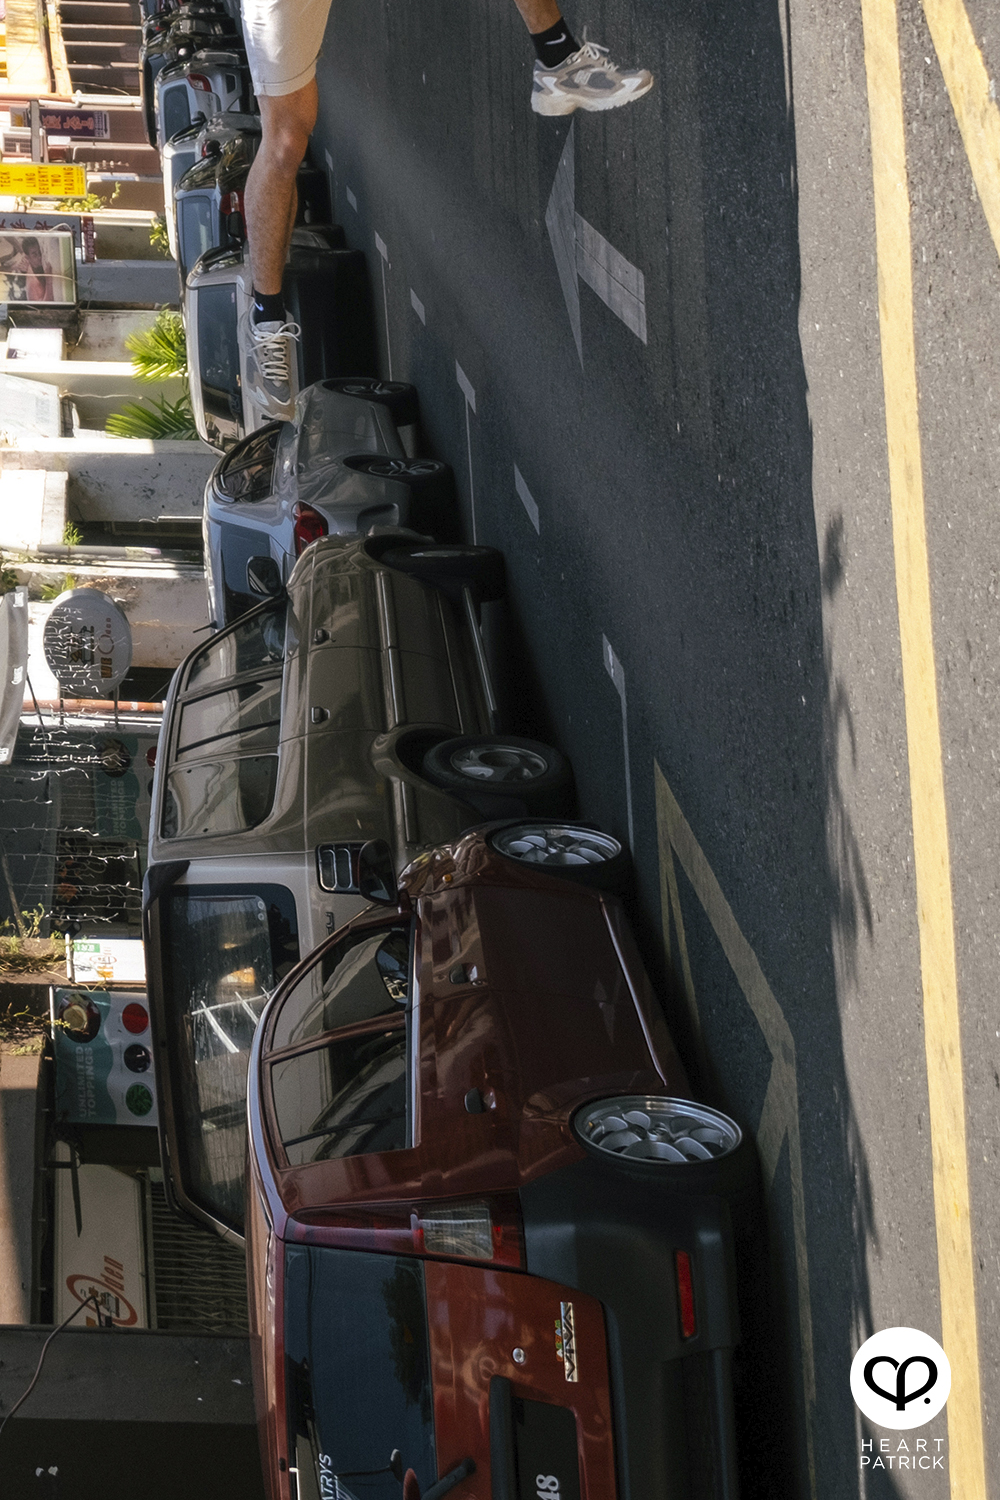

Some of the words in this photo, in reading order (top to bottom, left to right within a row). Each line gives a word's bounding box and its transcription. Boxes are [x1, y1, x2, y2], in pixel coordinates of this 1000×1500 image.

[0, 171, 11, 188] TECK
[26, 172, 37, 188] LING
[38, 166, 49, 195] SEVENTY
[51, 173, 61, 187] TWO
[63, 166, 75, 195] TRADING
[75, 1045, 88, 1117] UNLIMITED
[85, 1046, 97, 1117] TOPPINGS
[562, 1304, 576, 1380] VIVA
